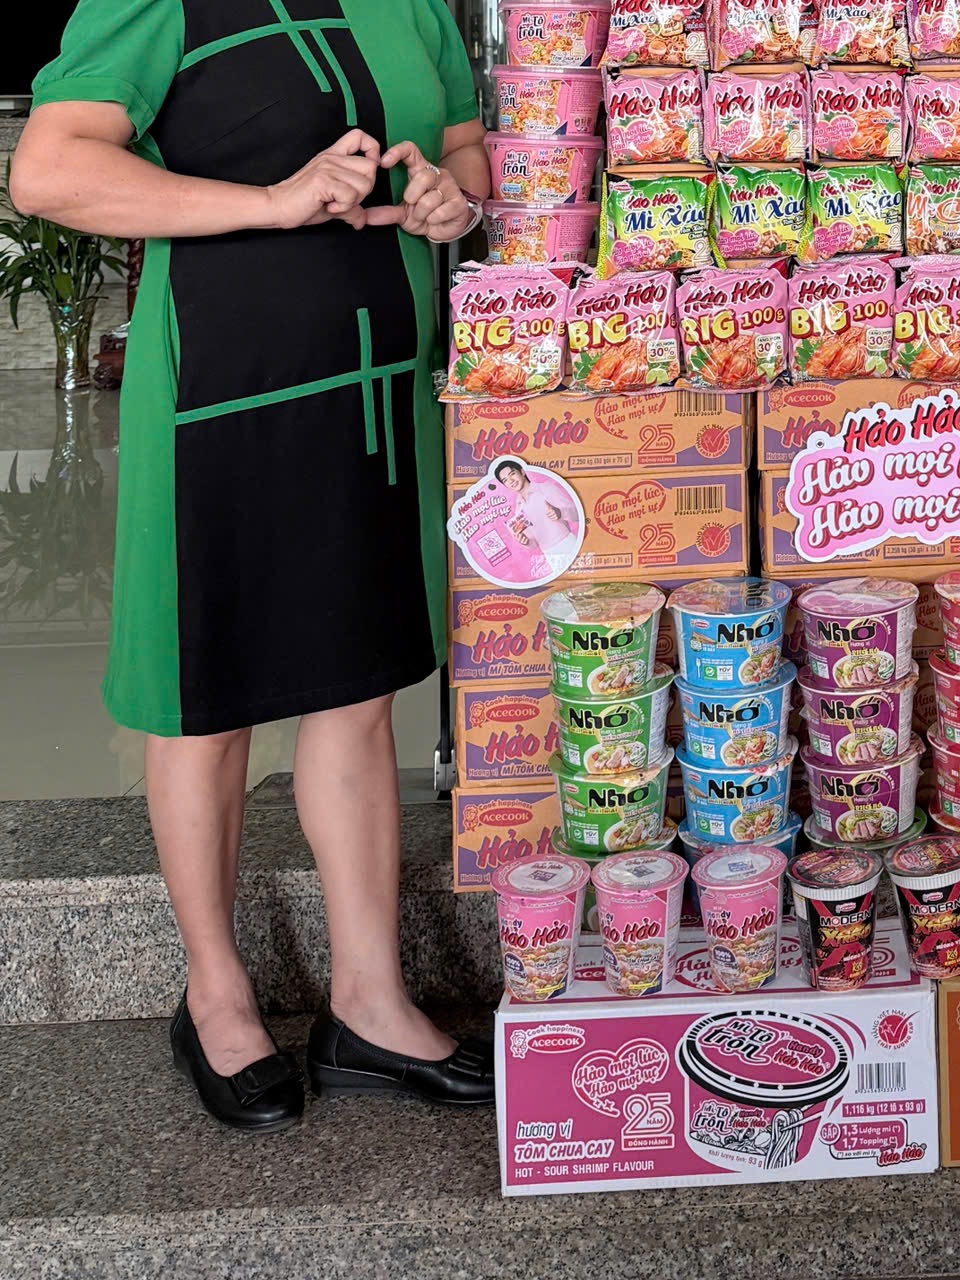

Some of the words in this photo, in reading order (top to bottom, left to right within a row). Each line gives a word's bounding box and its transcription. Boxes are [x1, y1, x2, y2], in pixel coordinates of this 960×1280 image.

[732, 278, 774, 302] Hảo
[682, 310, 737, 342] BIG
[742, 308, 771, 329] 100
[843, 409, 905, 453] Hảo
[799, 456, 874, 505] Hảo
[884, 442, 955, 486] mọi
[808, 499, 883, 548] Hảo
[717, 616, 775, 642] Nhớ
[532, 921, 568, 947] Hảo
[527, 1028, 545, 1037] Cook
[546, 1025, 584, 1035] happiness
[704, 1028, 770, 1062] trộn
[788, 1041, 824, 1058] Handy
[774, 1050, 799, 1069] Hảo
[576, 1066, 605, 1086] Hảo
[610, 1055, 635, 1075] mọi
[619, 1072, 642, 1090] mọi
[622, 1093, 674, 1137] 25
[844, 1105, 865, 1115] 1,116
[866, 1105, 874, 1114] kg
[877, 1103, 888, 1114] (12
[905, 1102, 914, 1111] 93
[915, 1102, 924, 1112] g)
[517, 1122, 555, 1139] hương
[560, 1119, 572, 1139] vị
[646, 1117, 663, 1125] NĂM
[821, 1123, 838, 1138] GẤP
[842, 1125, 858, 1136] 1,3
[859, 1126, 881, 1135] Lượng
[516, 1145, 545, 1161] TÔM
[549, 1143, 583, 1159] CHUA
[587, 1140, 613, 1157] CAY
[628, 1139, 647, 1147] ĐỒNG
[648, 1138, 668, 1146] HÀNH
[842, 1138, 858, 1148] 1,7
[859, 1137, 887, 1145] Topping
[515, 1168, 533, 1178] HOT
[544, 1165, 568, 1176] SOUR
[573, 1163, 609, 1174] SHRIMP
[613, 1161, 654, 1172] FLAVOUR
